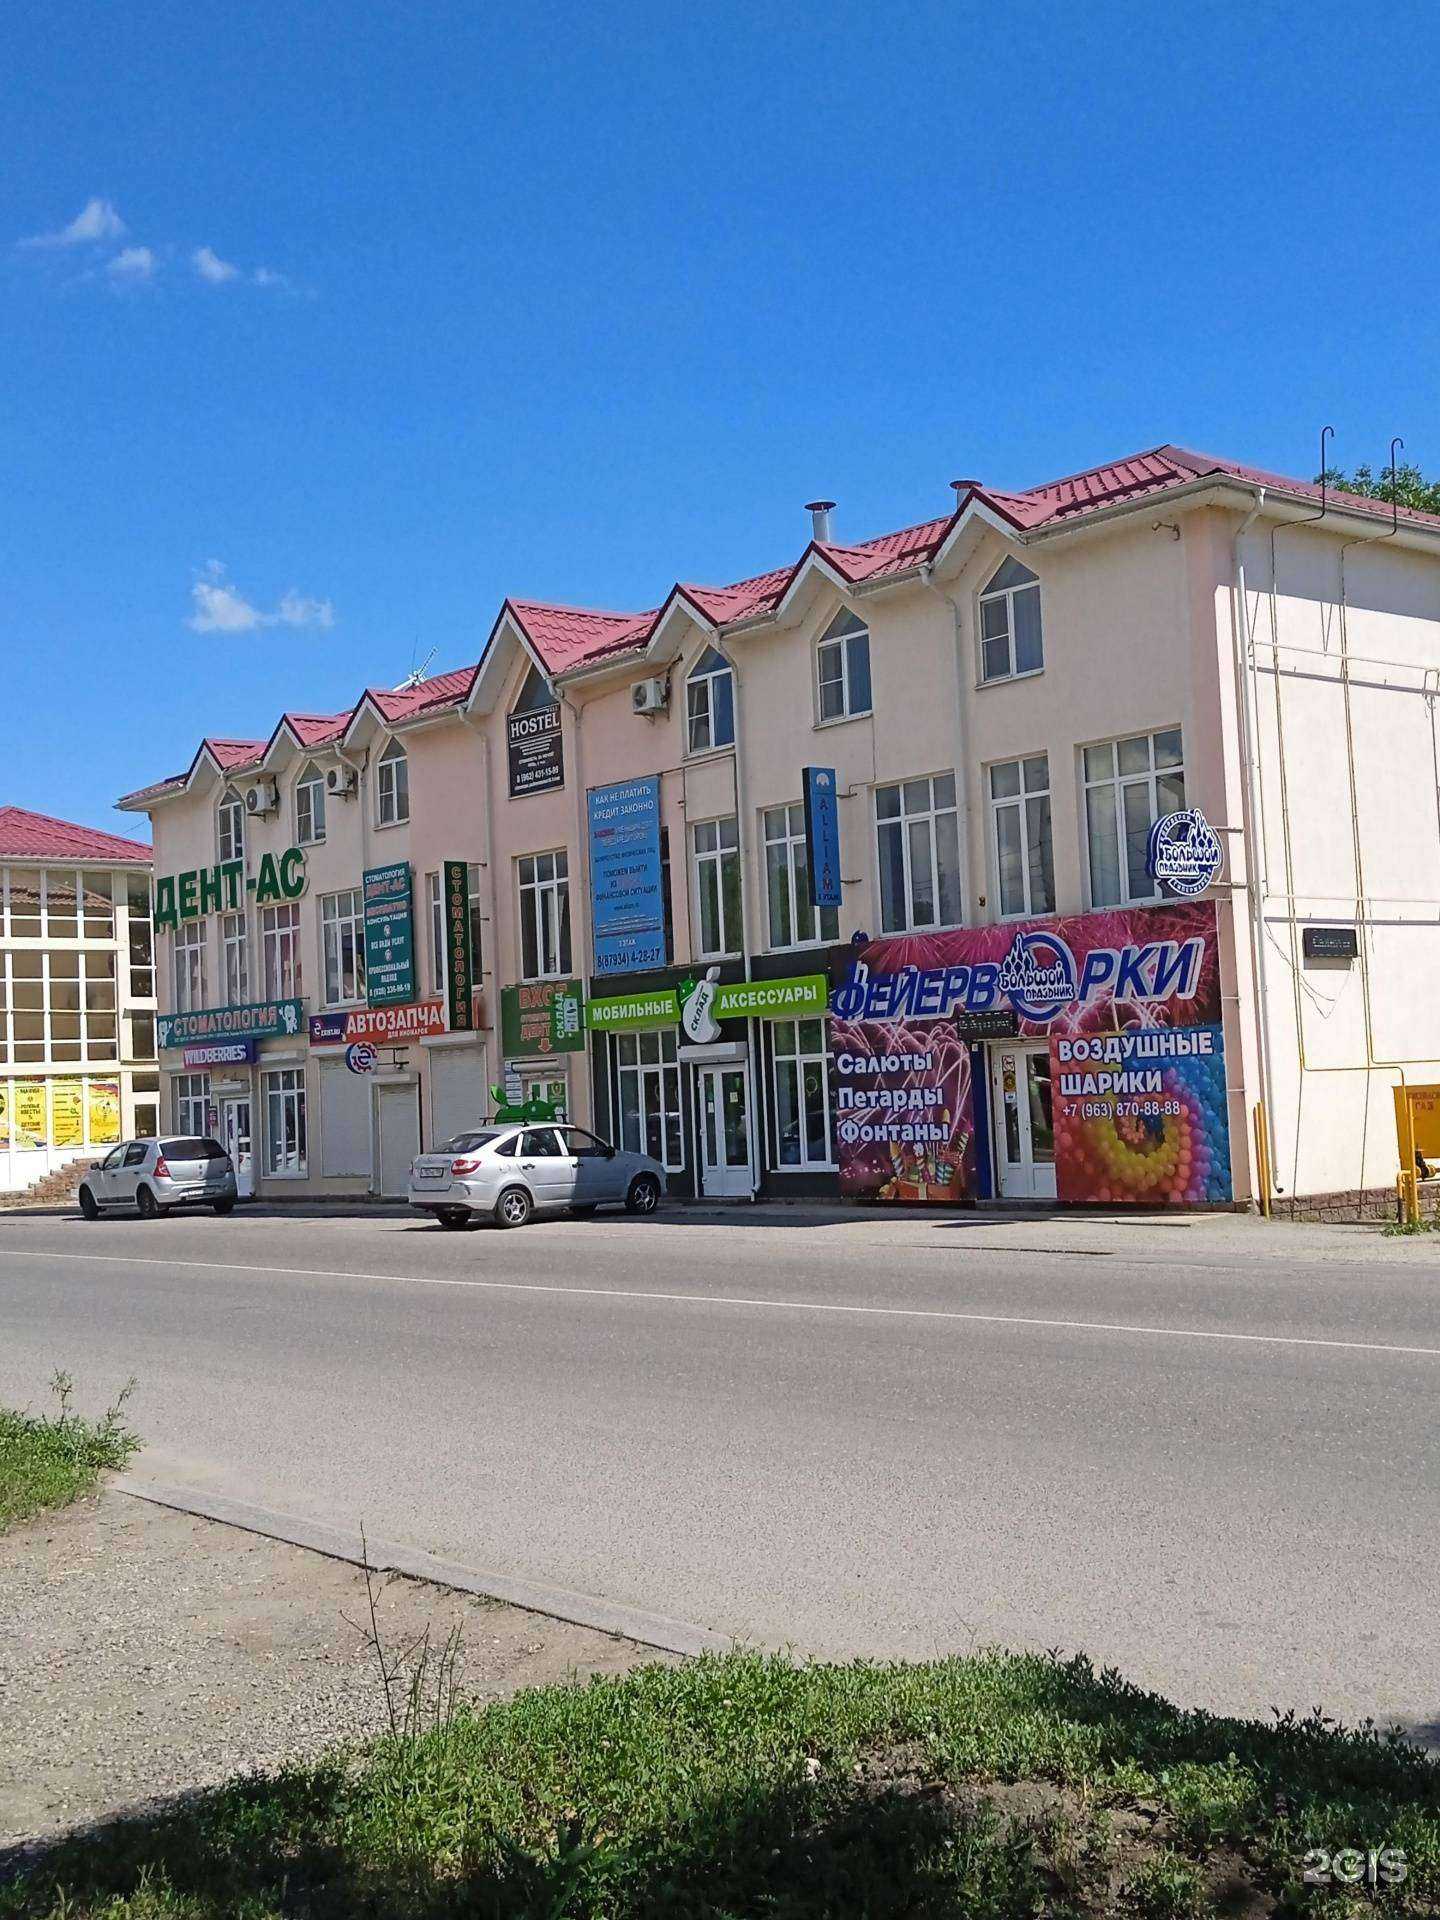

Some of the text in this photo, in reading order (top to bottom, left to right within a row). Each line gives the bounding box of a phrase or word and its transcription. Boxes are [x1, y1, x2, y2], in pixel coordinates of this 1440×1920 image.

[511, 712, 560, 738] HOSTEL
[595, 786, 652, 805] КАК НЕ ПЛАТИТЬ
[593, 800, 654, 820] КРЕДИТ ЗАКОННО
[1165, 847, 1218, 862] БОЛЬШОЙ
[365, 868, 405, 884] СТОМАТОЛОГИЯ
[154, 847, 306, 934] ДЕНТ-АС
[451, 865, 467, 1027] СТОМАТОЛОГИЯ
[1000, 962, 1064, 989] БОЛЬШОЙ
[720, 985, 817, 1009] АКСЕССУАРЫ
[1025, 985, 1073, 999] ПРАЗДНИК
[173, 1006, 277, 1036] СТОМАТОЛОГИЯ
[554, 992, 566, 1039] СКЛАД
[592, 1000, 673, 1021] МОБИЛЬНЫЕ
[691, 992, 709, 1032] СКЛАД
[388, 1030, 398, 1039] ДЛЯ
[184, 1044, 246, 1066] WILDBERRIES
[1059, 1032, 1213, 1062] ВОЗДУШНЫЕ
[836, 1052, 932, 1075] Салюты
[1060, 1070, 1162, 1095] ШАРИКИ
[838, 1087, 943, 1112] Петарды
[1062, 1100, 1181, 1120] +7 (963) 870-88-88
[840, 1119, 949, 1143] Фонтаны
